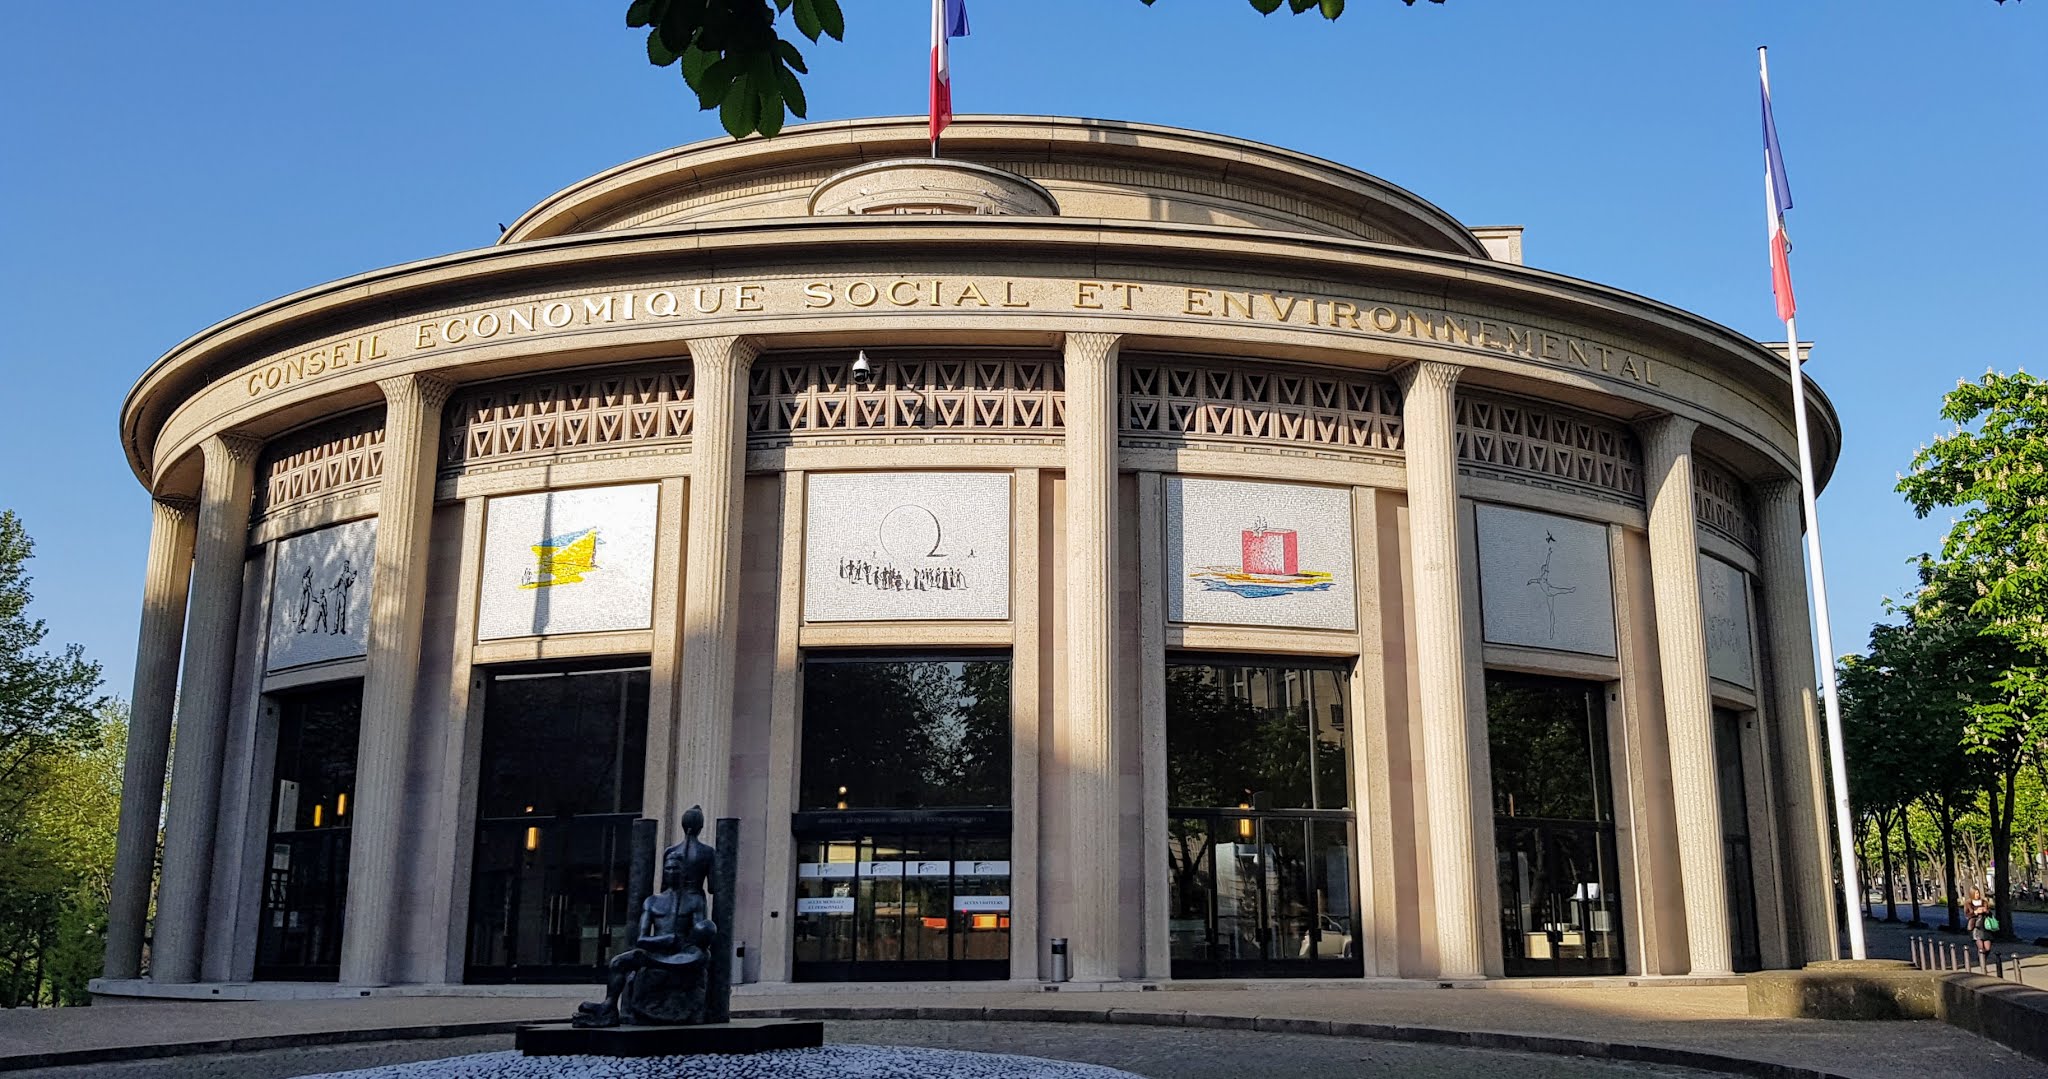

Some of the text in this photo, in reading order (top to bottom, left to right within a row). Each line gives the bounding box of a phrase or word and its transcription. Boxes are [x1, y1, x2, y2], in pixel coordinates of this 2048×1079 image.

[247, 281, 1660, 397] CONSEIL ECONOMIQUE SOCIAL ET ENVIRONNEMENTAL
